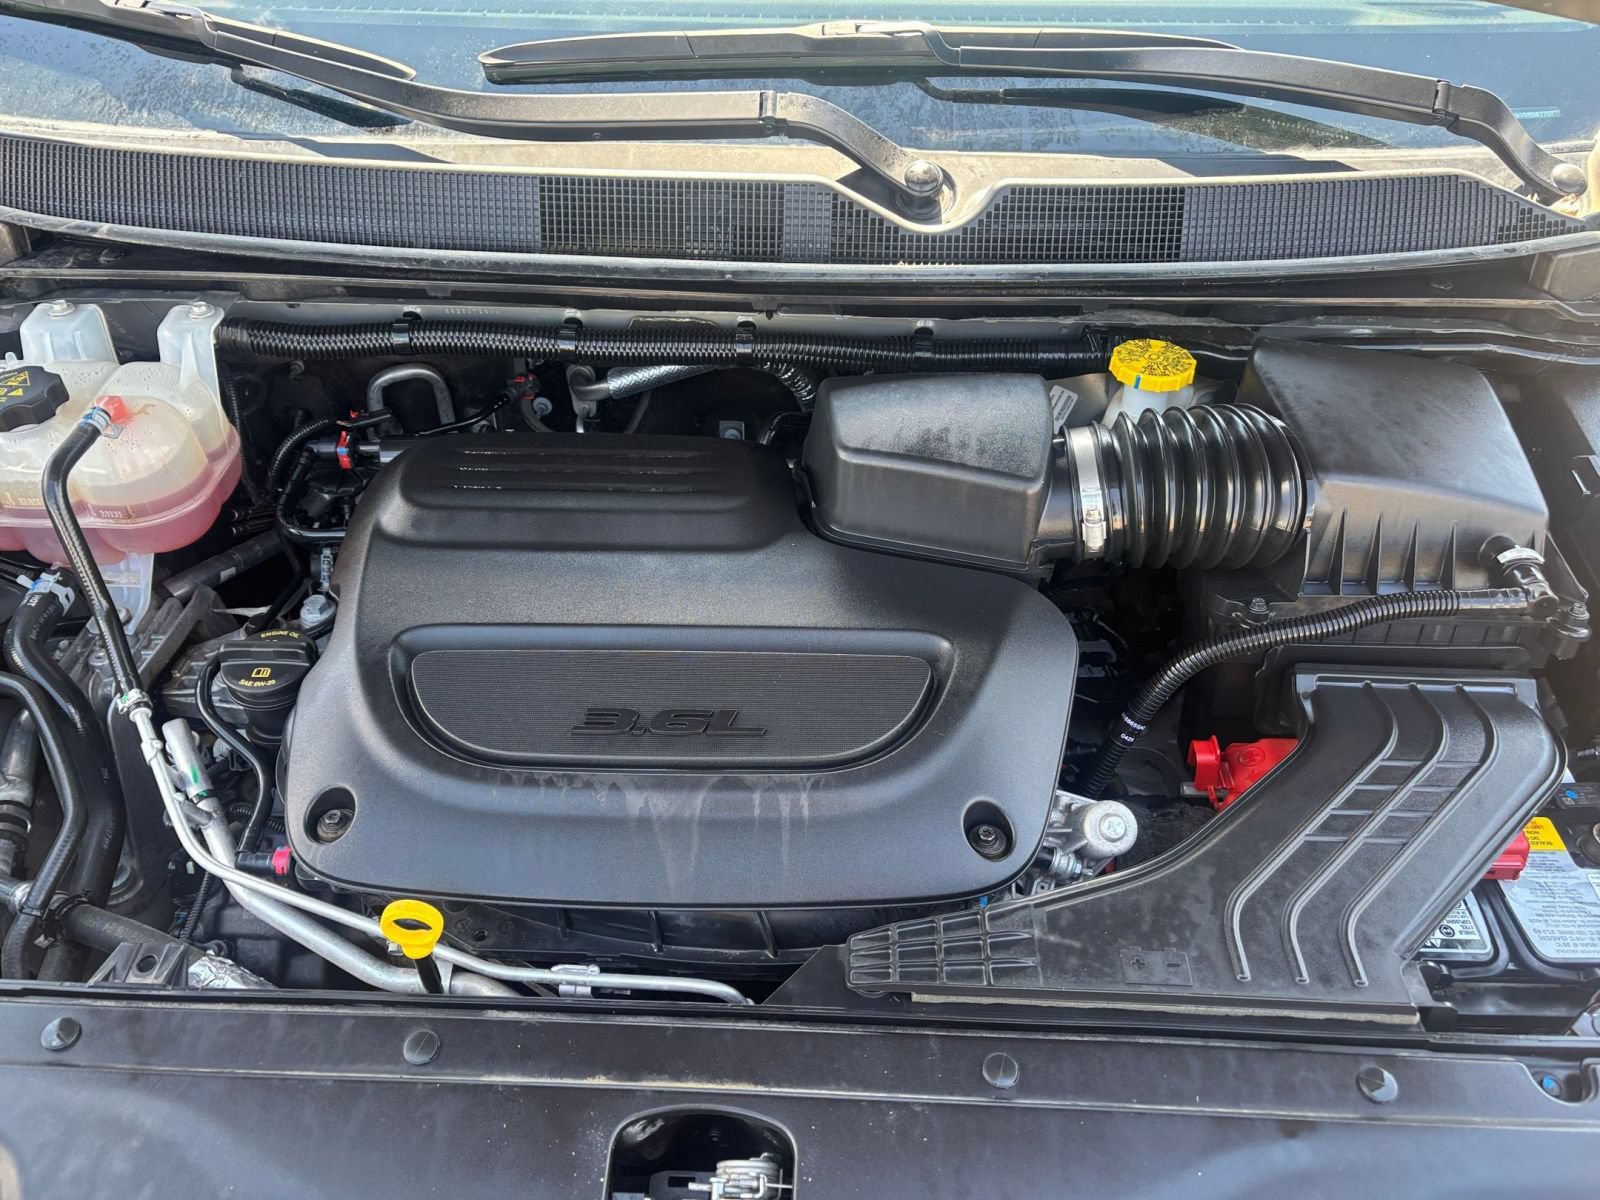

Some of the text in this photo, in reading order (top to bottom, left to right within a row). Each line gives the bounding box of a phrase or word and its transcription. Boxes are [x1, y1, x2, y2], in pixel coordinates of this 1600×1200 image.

[260, 630, 289, 638] ENGINE
[239, 679, 253, 687] SAE
[570, 707, 767, 736] 3.6L
